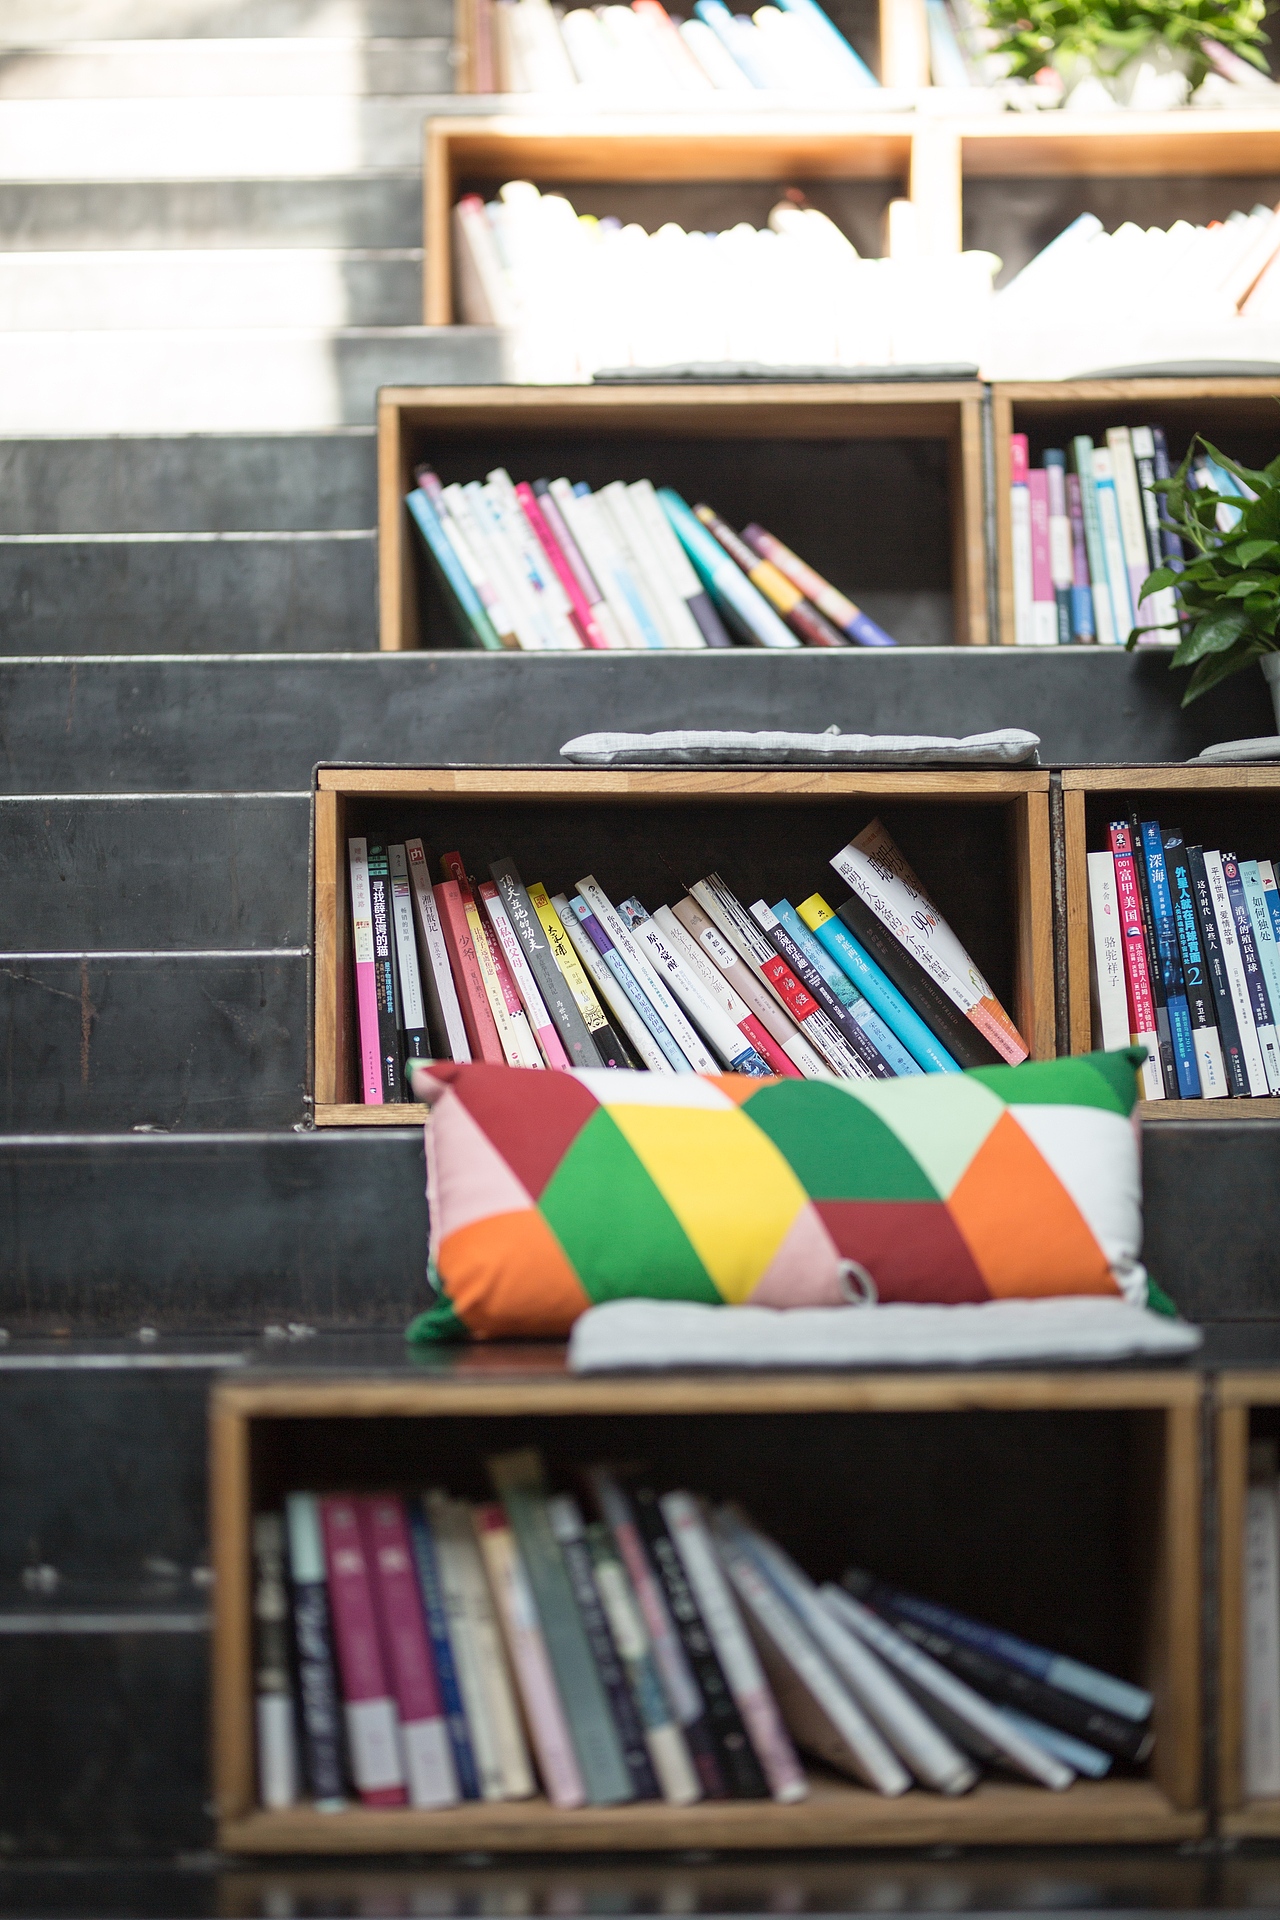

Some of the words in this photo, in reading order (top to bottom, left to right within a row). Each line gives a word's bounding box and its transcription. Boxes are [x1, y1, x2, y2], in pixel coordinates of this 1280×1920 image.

[1117, 860, 1130, 868] 001
[1149, 853, 1166, 883] 深海
[421, 894, 438, 932] 湘行散记
[1103, 882, 1110, 900] 老舍
[1119, 869, 1138, 923] 富甲美国
[1211, 866, 1234, 946] 平行世界·爱情故事
[372, 880, 389, 957] 寻找薛定谔的猫
[839, 861, 952, 984] 聪明女人必备的99个办事智慧
[911, 910, 934, 939] 99
[1174, 866, 1202, 964] 外星人就在月球背面
[1197, 880, 1212, 915] 这个时代
[1205, 923, 1218, 950] 这些人
[1252, 896, 1271, 942] 如何独处
[459, 935, 475, 960] 少爷
[496, 916, 524, 968] 自私的父母
[646, 931, 679, 972] 原力觉醒
[669, 928, 725, 993] 牧羊少年奇幻之旅
[704, 931, 733, 964] 雾都孤儿
[774, 928, 809, 971] 发现的乐趣
[834, 932, 870, 974] 海底两万里
[876, 922, 914, 969] TRAUMDEUTUNG
[1104, 936, 1119, 987] 骆驼祥子
[1234, 905, 1258, 973] 消失的殖民星球
[470, 971, 485, 999] 夏目漱石
[609, 953, 666, 1034] 午夜十字路口梦见弗洛伊德
[1187, 967, 1203, 986] 2
[921, 978, 943, 1005] SIGMUND
[941, 1005, 959, 1024] FREUD
[1195, 1000, 1206, 1023] 李卫东
